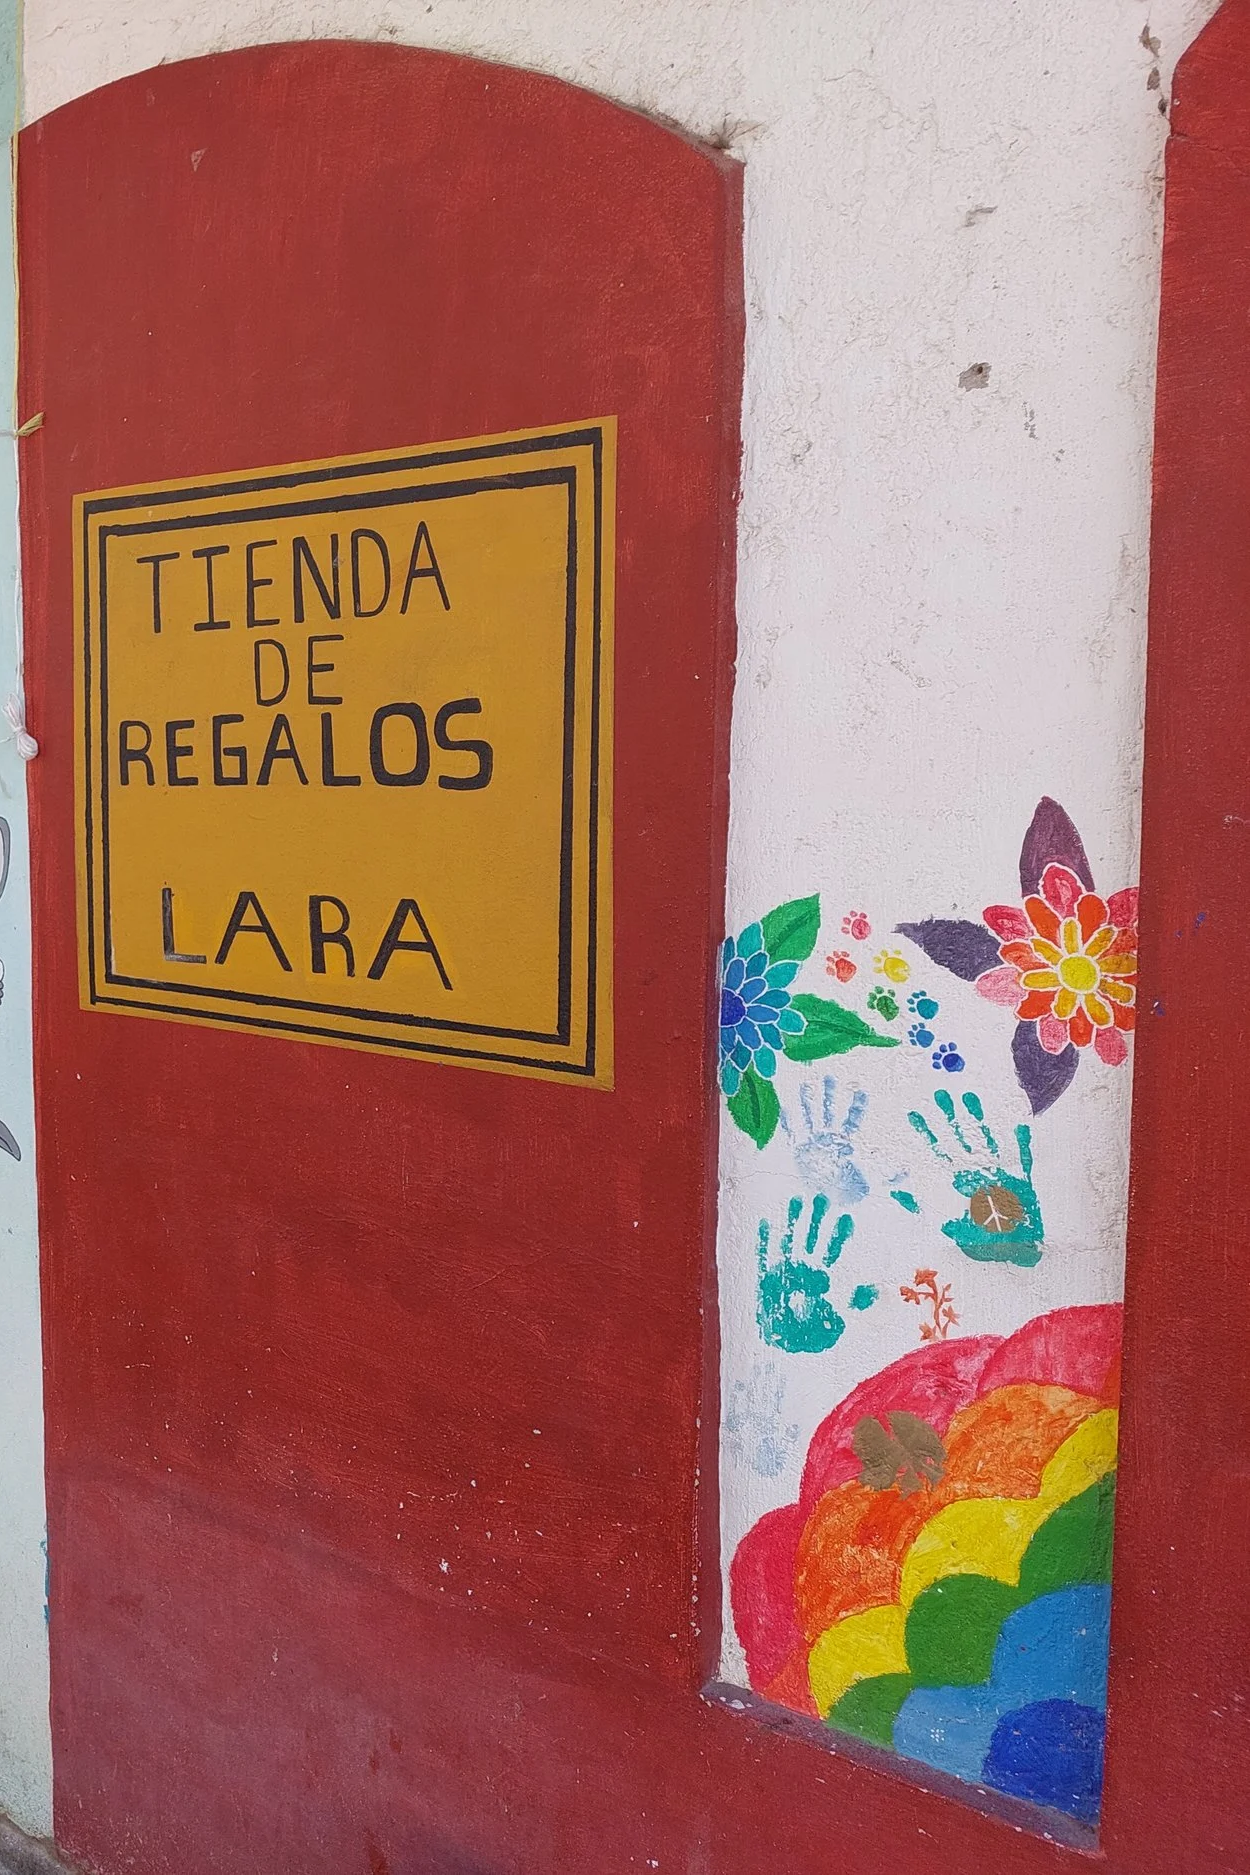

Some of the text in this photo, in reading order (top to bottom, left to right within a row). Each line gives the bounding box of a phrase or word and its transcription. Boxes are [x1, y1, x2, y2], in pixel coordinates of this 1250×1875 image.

[136, 520, 451, 634] TIENDA
[254, 633, 345, 706] DE
[119, 697, 494, 791] REGALOS
[161, 884, 453, 991] LARA
